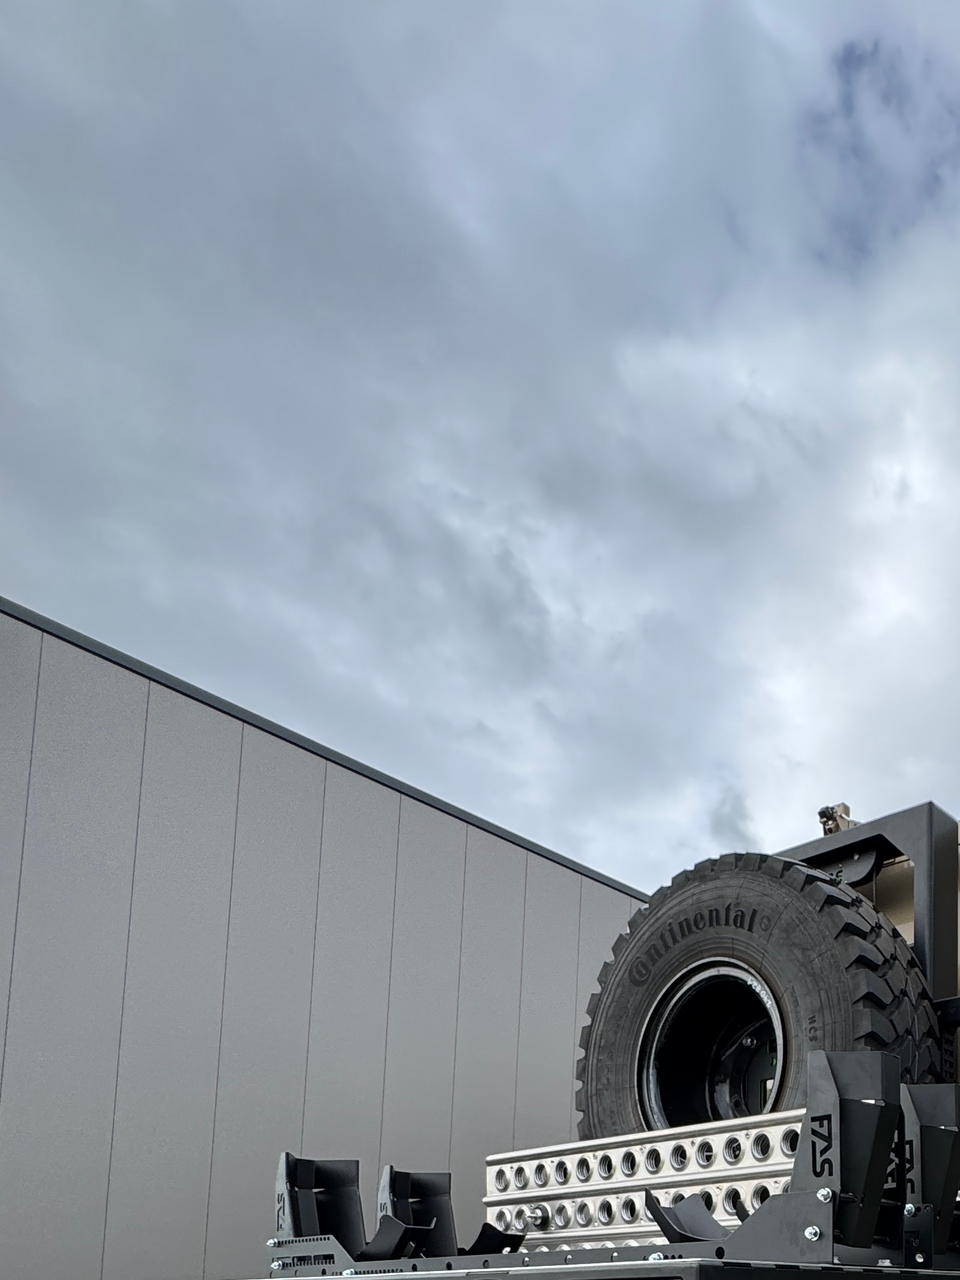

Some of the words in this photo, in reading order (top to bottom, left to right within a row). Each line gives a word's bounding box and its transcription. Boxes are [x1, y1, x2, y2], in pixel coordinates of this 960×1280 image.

[628, 901, 759, 988] Continental
[810, 1114, 833, 1178] FAS
[277, 1193, 285, 1232] FAS
